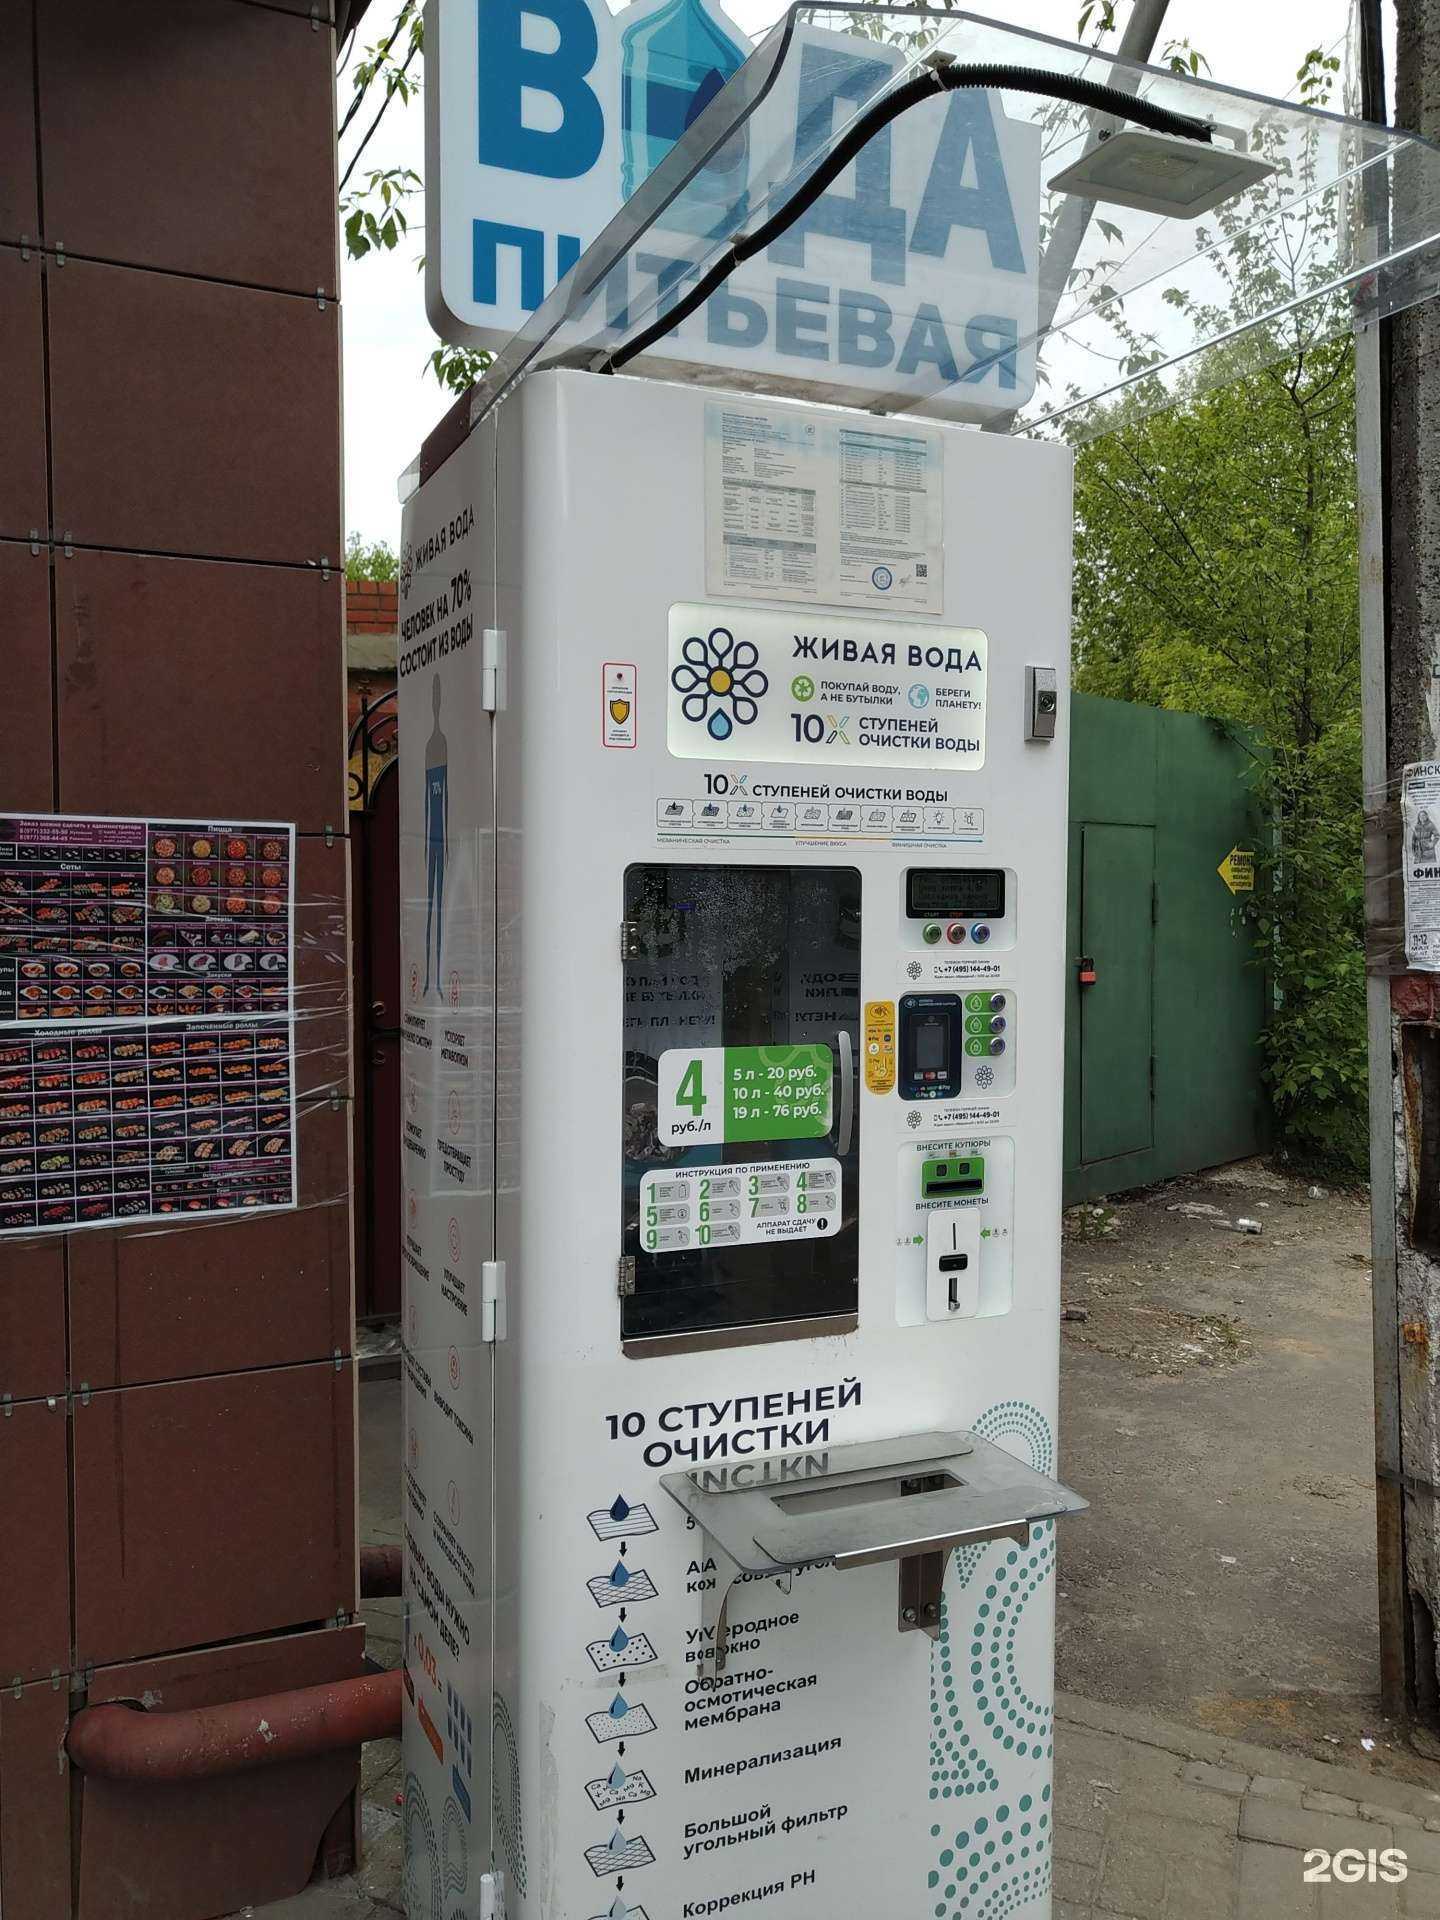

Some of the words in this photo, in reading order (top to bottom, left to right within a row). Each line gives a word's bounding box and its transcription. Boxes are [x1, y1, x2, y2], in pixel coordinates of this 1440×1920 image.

[473, 219, 1017, 388] ПИТЬЕВАЯ
[415, 528, 446, 572] ЖИВАЯ
[450, 504, 474, 548] ВОДА
[401, 602, 435, 642] ЧЕЛОВЕК
[436, 595, 449, 621] НА
[450, 568, 472, 612] 70%
[400, 636, 437, 677] СОСТОИТ
[438, 632, 449, 657] ИЗ
[450, 613, 473, 651] ВОДЫ
[792, 636, 896, 664] ЖИВАЯ
[908, 645, 982, 673] ВОДА
[821, 681, 869, 692] ПОКУПАЙ
[872, 685, 901, 696] ВОДУ,
[936, 688, 971, 697] БЕРЕГИ
[820, 694, 828, 702] А
[830, 694, 842, 703] НЕ
[846, 695, 893, 705] БУТЫЛКИ
[936, 700, 982, 710] ПЛАНЕТУ!
[859, 716, 938, 733] СТУПЕНЕЙ
[859, 734, 930, 749] ОЧИСТКИ
[935, 738, 979, 752] ВОДЫ
[753, 784, 829, 799] СТУПЕНЕЙ
[835, 787, 901, 800] ОЧИСТКИ
[906, 790, 948, 803] ВОДЫ
[208, 825, 232, 833] Пицца
[952, 965, 969, 973] (495)
[733, 1069, 742, 1081] 5
[745, 1070, 755, 1080] л
[767, 1067, 784, 1080] 20
[788, 1065, 817, 1081] руб.
[676, 1060, 706, 1116] 4
[733, 1088, 748, 1099] 10
[751, 1089, 761, 1099] л
[773, 1086, 791, 1098] 40
[795, 1084, 824, 1099] руб.
[733, 1107, 747, 1118] 19
[750, 1108, 760, 1118] л
[773, 1105, 789, 1116] 76
[793, 1103, 822, 1118] руб.
[970, 1111, 999, 1119] 144-49-01
[671, 1119, 711, 1135] руб./л
[917, 1143, 952, 1152] ВНЕСИТЕ
[955, 1140, 991, 1149] КУПЮРЫ
[675, 1168, 733, 1179] ИНСТРУКЦИЯ
[736, 1166, 748, 1174] ПО
[750, 1163, 810, 1172] ПРИМЕНЕНИЮ
[700, 1179, 710, 1199] 2
[748, 1175, 759, 1195] 3
[797, 1172, 807, 1191] 4
[647, 1183, 656, 1203] 1
[700, 1202, 709, 1222] 6
[748, 1198, 760, 1218] 7
[797, 1194, 807, 1213] 8
[915, 1200, 951, 1210] ВНЕСИТЕ
[953, 1198, 989, 1208] МОНЕТЫ
[647, 1206, 658, 1227] 5
[756, 1220, 790, 1229] АППАРАТ
[792, 1218, 816, 1226] СДАЧУ
[647, 1229, 657, 1249] 9
[695, 1225, 711, 1245] 10
[777, 1226, 807, 1234] ВЫДАЕТ
[605, 1411, 645, 1440] 10
[658, 1376, 863, 1432] СТУПЕНЕЙ
[643, 1418, 829, 1468] ОЧИСТКИ
[686, 1516, 695, 1530] 5
[426, 1562, 444, 1606] ВОДЫ
[445, 1594, 470, 1645] НУЖНО
[417, 1579, 439, 1629] САМОМ
[440, 1618, 460, 1662] ДЕЛЕ?
[685, 1668, 773, 1694] Обратно-
[685, 1674, 817, 1712] осмотическая
[685, 1700, 781, 1730] мембрана
[685, 1736, 842, 1784] Минерализация
[684, 1804, 771, 1838] Большой
[683, 1820, 776, 1860] угольный
[781, 1804, 848, 1833] фильтр
[683, 1881, 784, 1918] Коррекция
